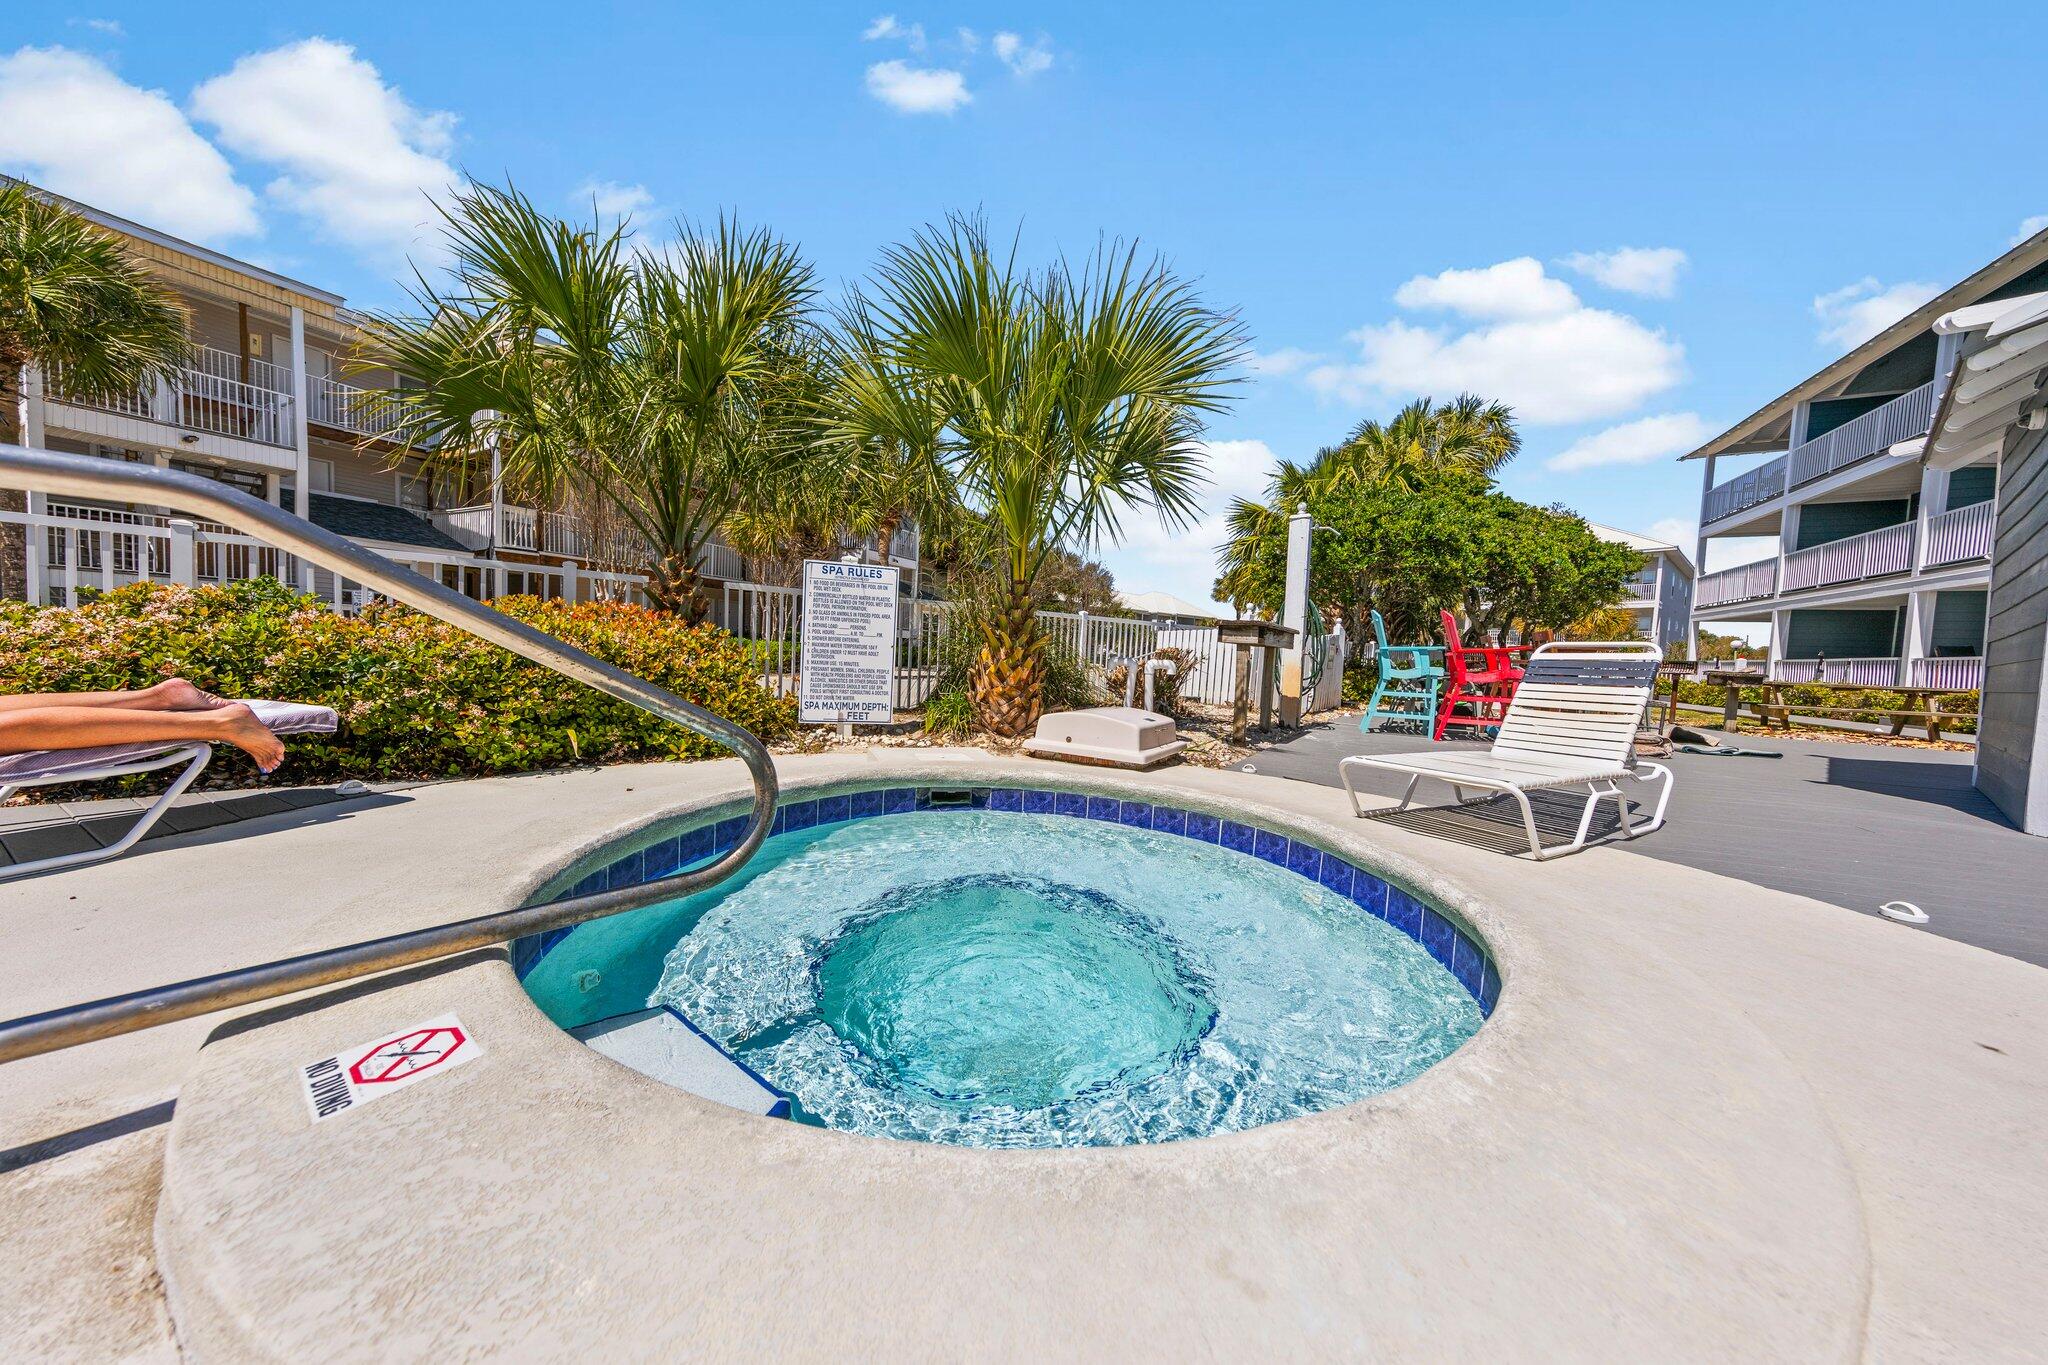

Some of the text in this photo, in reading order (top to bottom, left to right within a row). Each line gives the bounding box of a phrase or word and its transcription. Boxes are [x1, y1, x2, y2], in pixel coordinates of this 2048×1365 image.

[822, 565, 844, 575] SPA
[848, 568, 882, 579] RULES
[804, 701, 889, 712] SPA MAXIMUM DEPTH:
[847, 712, 870, 720] FEET
[305, 1057, 353, 1117] NO DIVING
